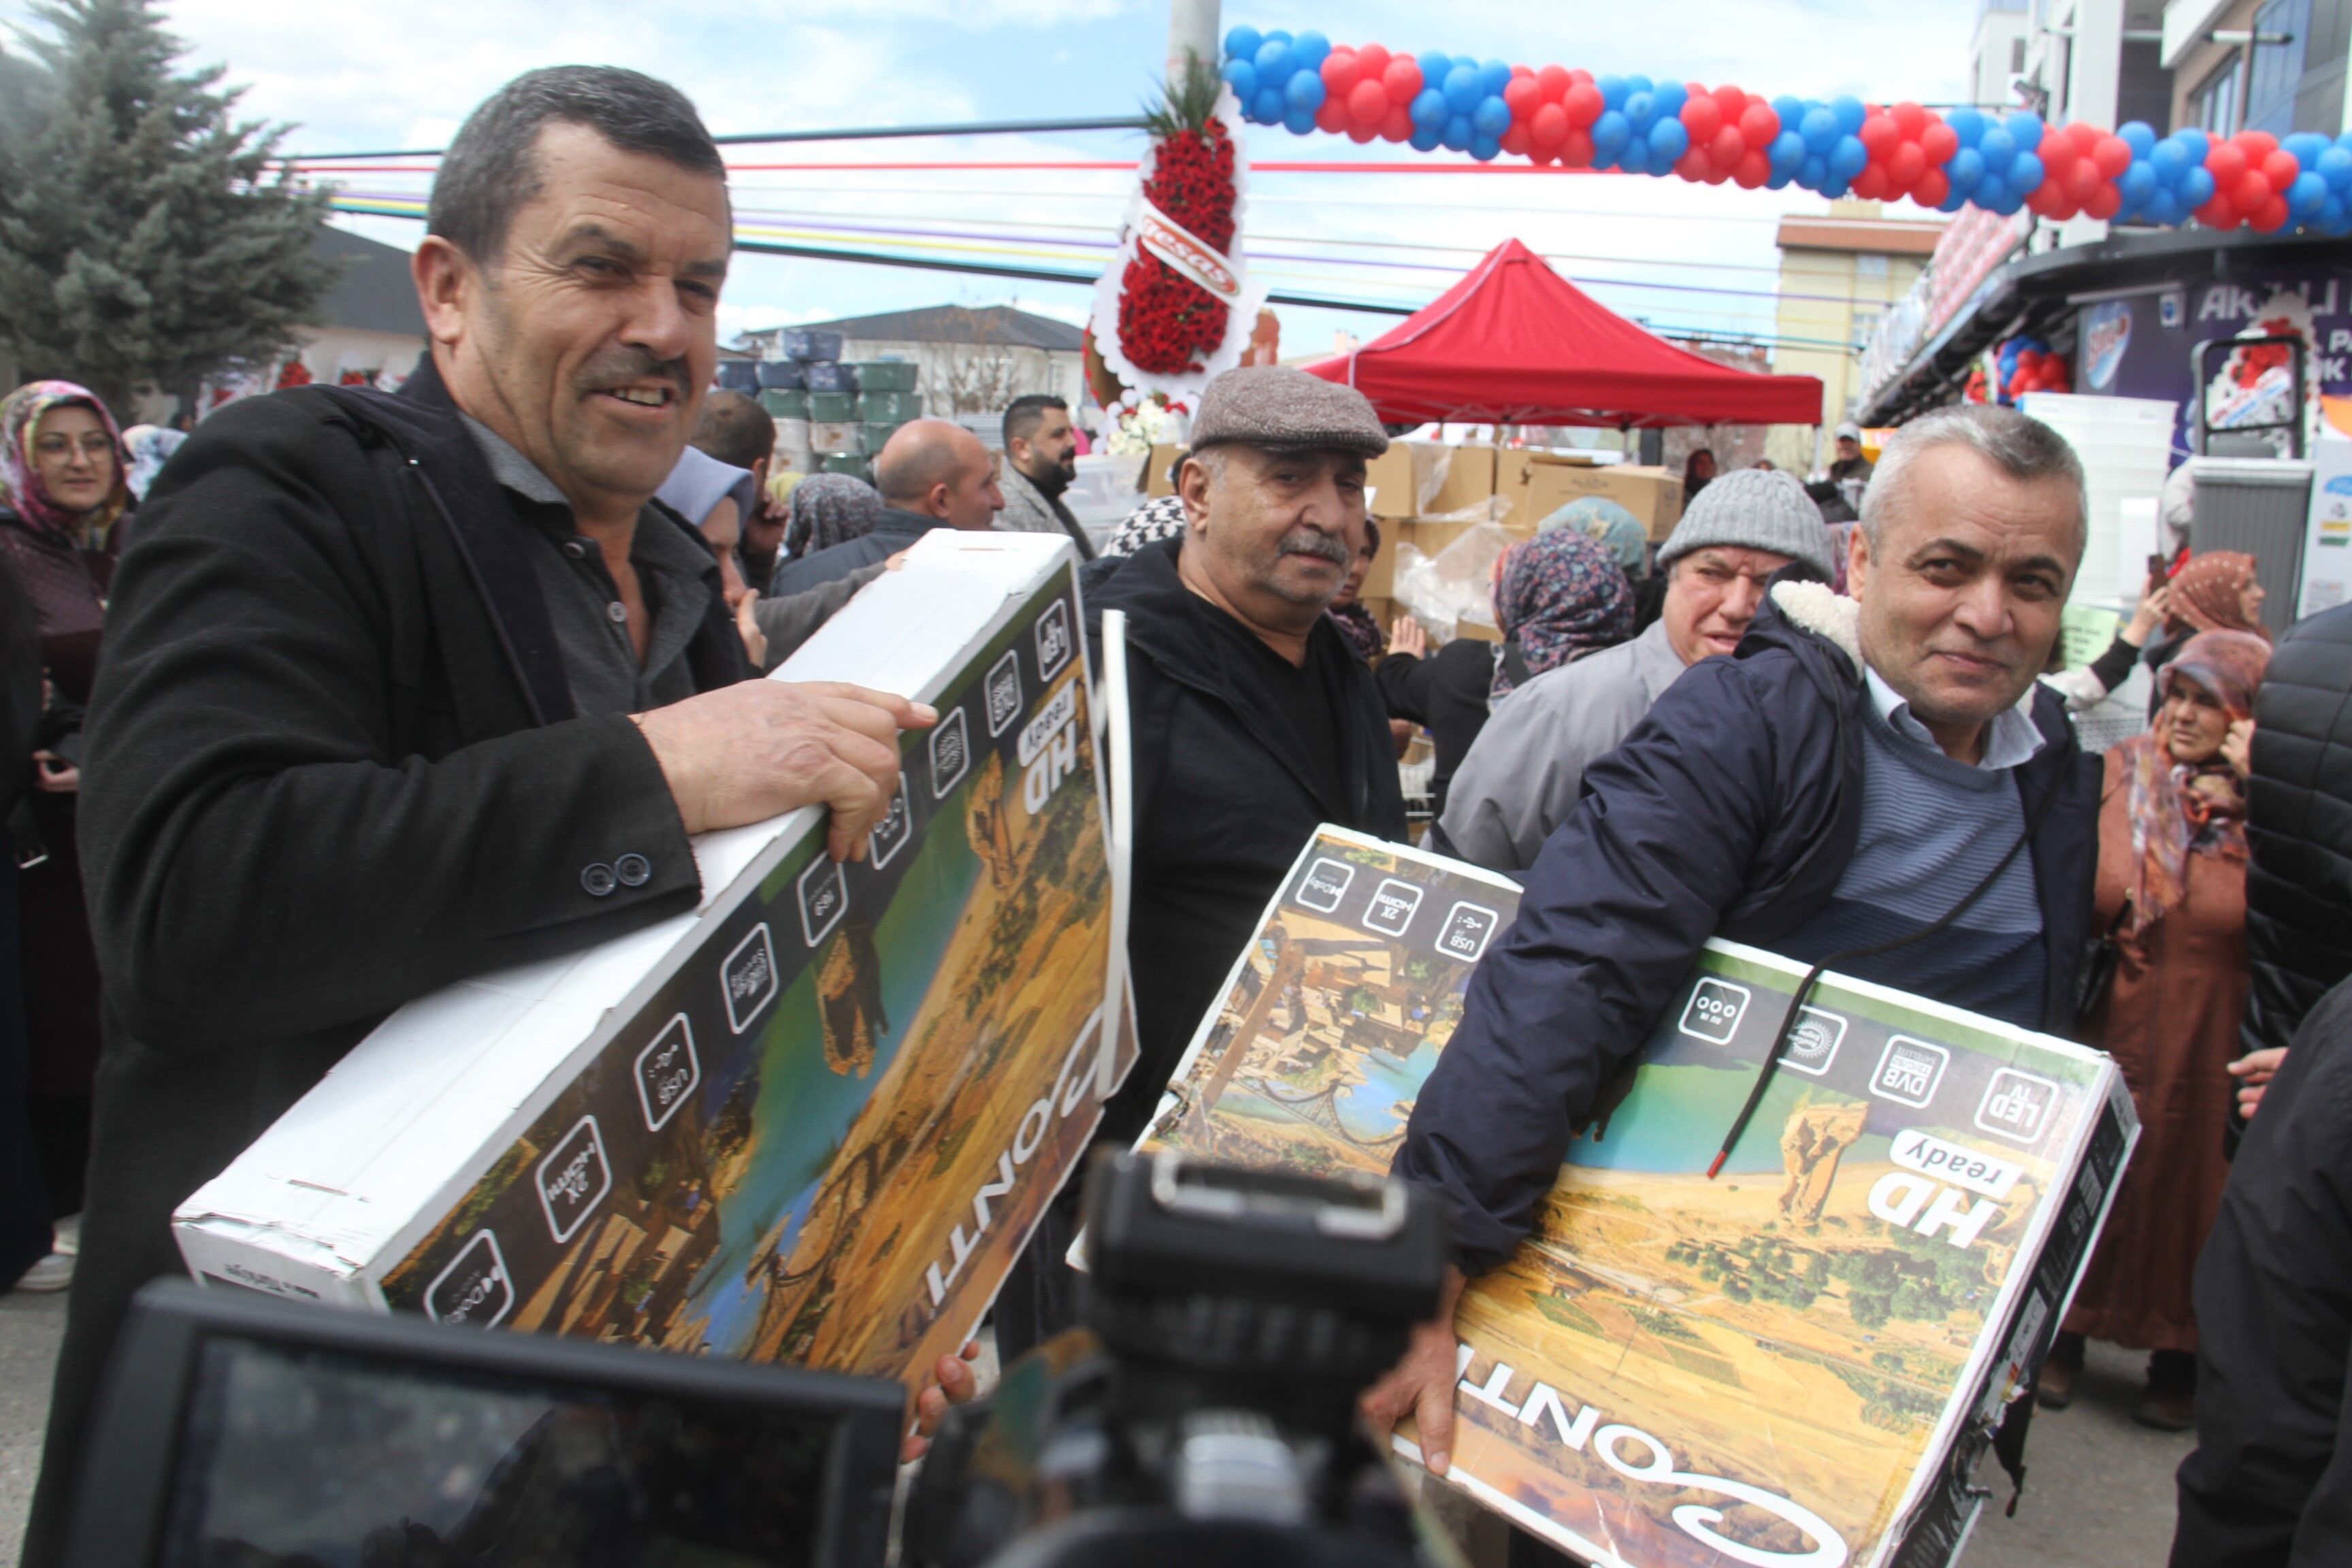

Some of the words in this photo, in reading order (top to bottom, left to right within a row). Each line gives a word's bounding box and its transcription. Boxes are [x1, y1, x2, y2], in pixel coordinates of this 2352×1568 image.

[1024, 721, 1075, 815] HD
[1381, 905, 1399, 919] 2X
[1450, 935, 1475, 951] USB
[1882, 1068, 1927, 1096] DVB
[2009, 1085, 2031, 1102] TV
[1989, 1094, 2041, 1128] LED
[1905, 1139, 2003, 1185] ready
[1867, 1172, 1999, 1249] HD
